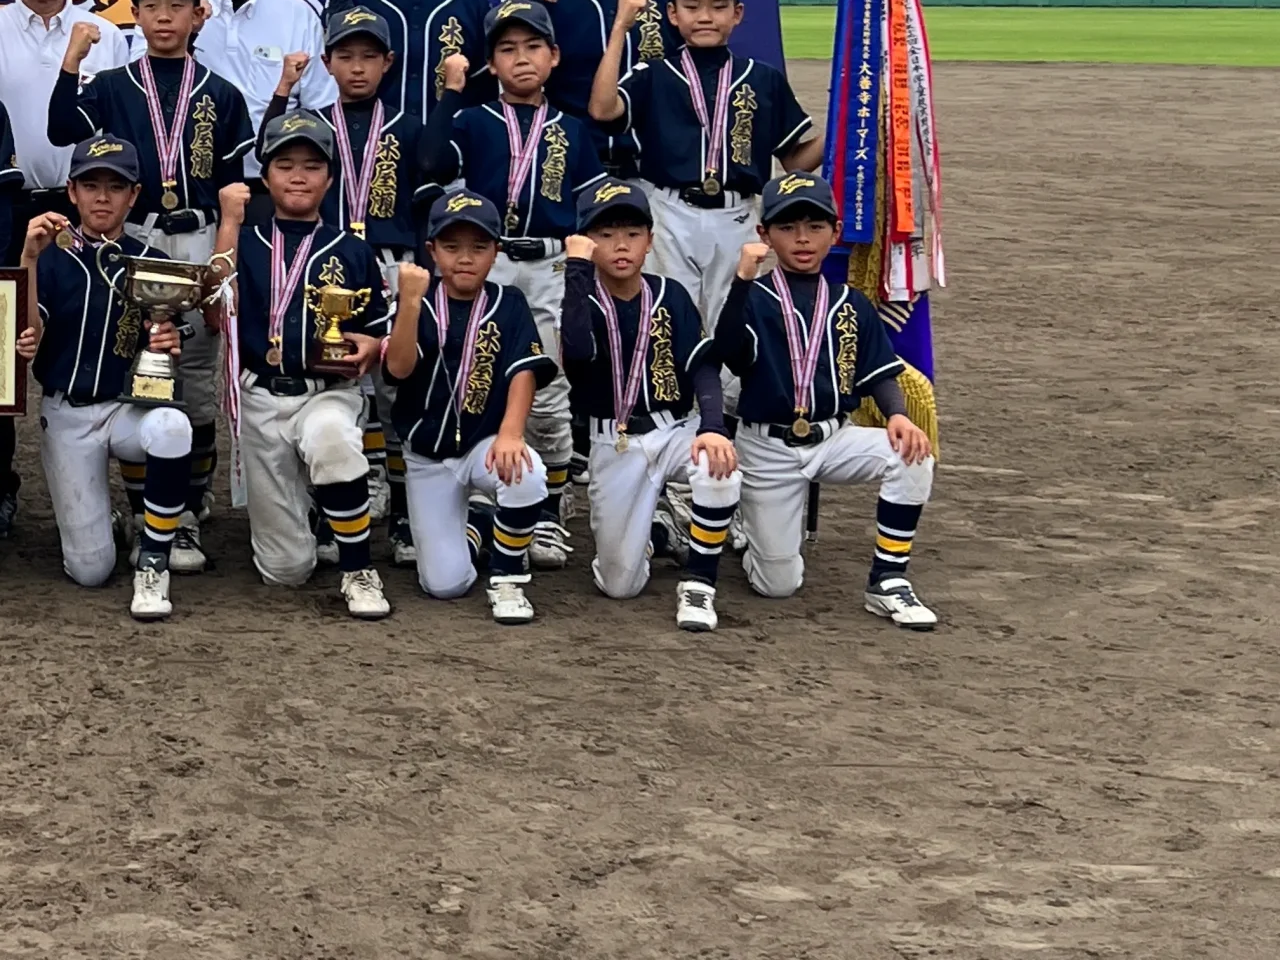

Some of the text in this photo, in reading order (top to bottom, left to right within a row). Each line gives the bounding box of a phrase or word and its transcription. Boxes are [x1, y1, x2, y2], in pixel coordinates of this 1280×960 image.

[369, 133, 401, 218] 木屋瀬
[651, 306, 681, 401] 木屋瀬
